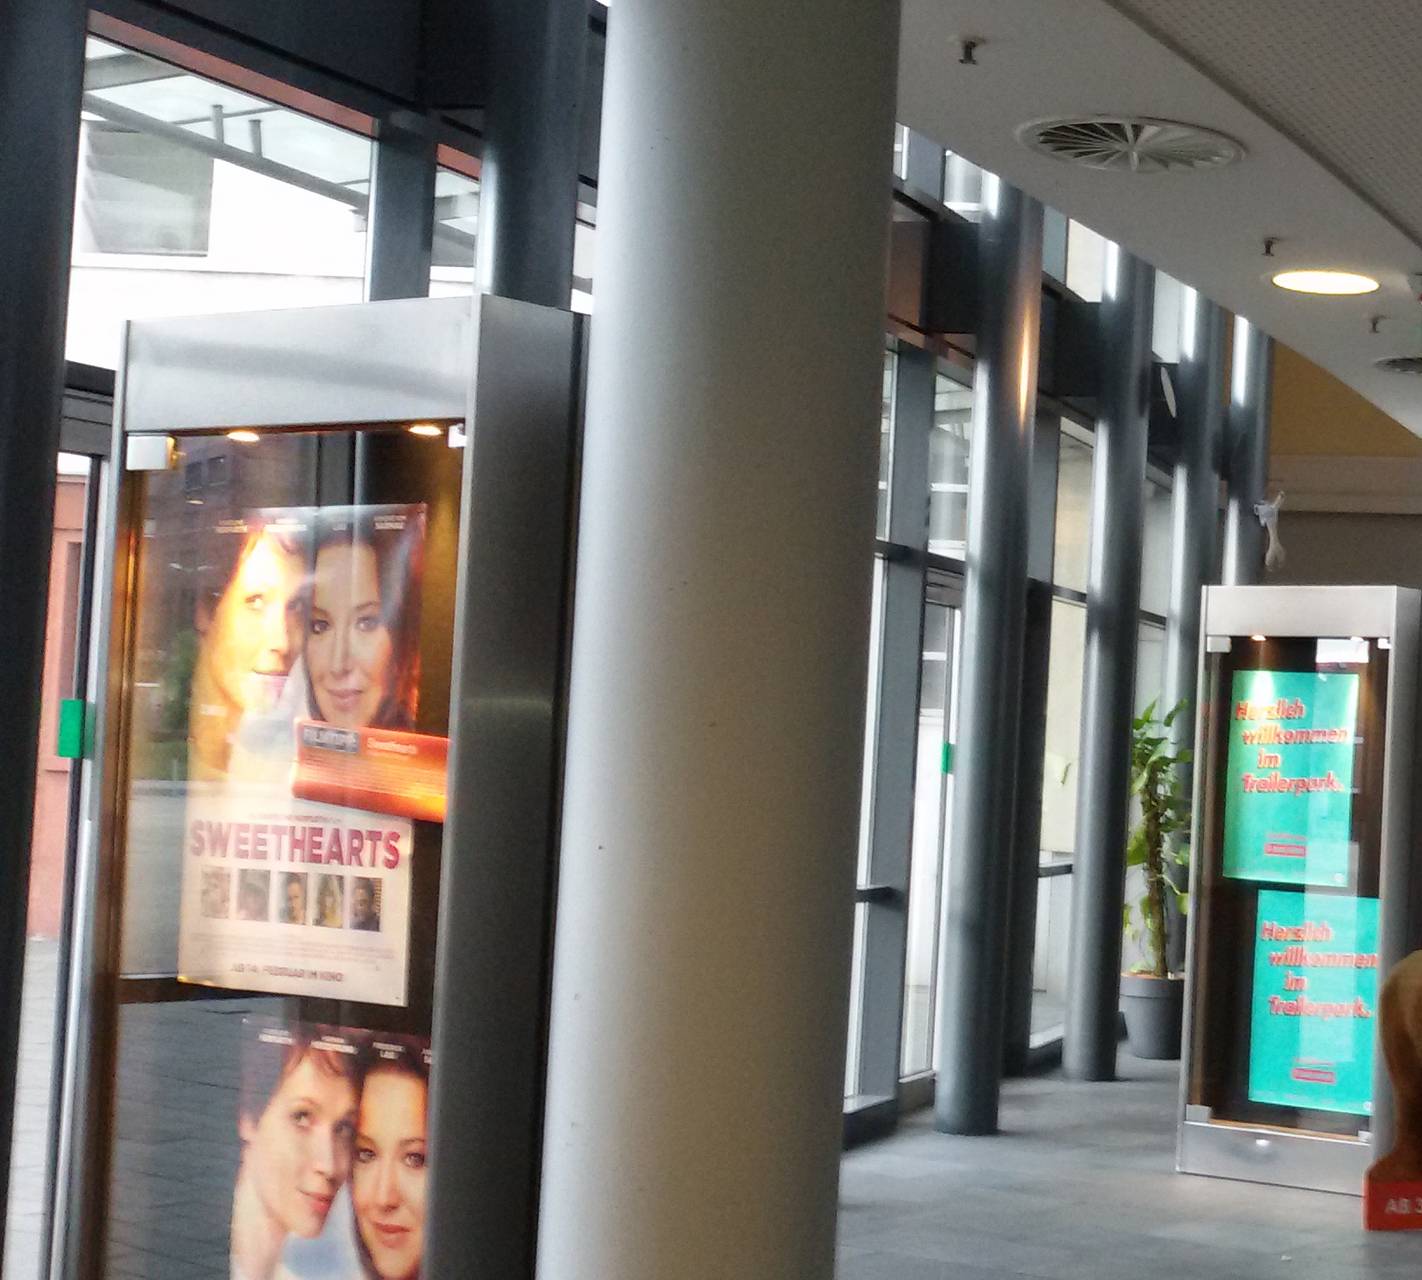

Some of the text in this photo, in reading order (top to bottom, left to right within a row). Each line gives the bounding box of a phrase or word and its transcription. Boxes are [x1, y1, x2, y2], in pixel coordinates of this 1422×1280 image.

[1236, 698, 1305, 720] Herzlich
[1242, 725, 1348, 745] willkommen
[1257, 749, 1280, 769] im
[1242, 771, 1345, 796] Trailerpark.
[190, 819, 401, 870] SWEETHEARTS
[1261, 921, 1332, 942] Herzlich
[1269, 946, 1380, 968] willkommen
[1284, 971, 1306, 991] im
[1269, 995, 1371, 1021] Trailerpark.
[1385, 1198, 1409, 1214] AB
